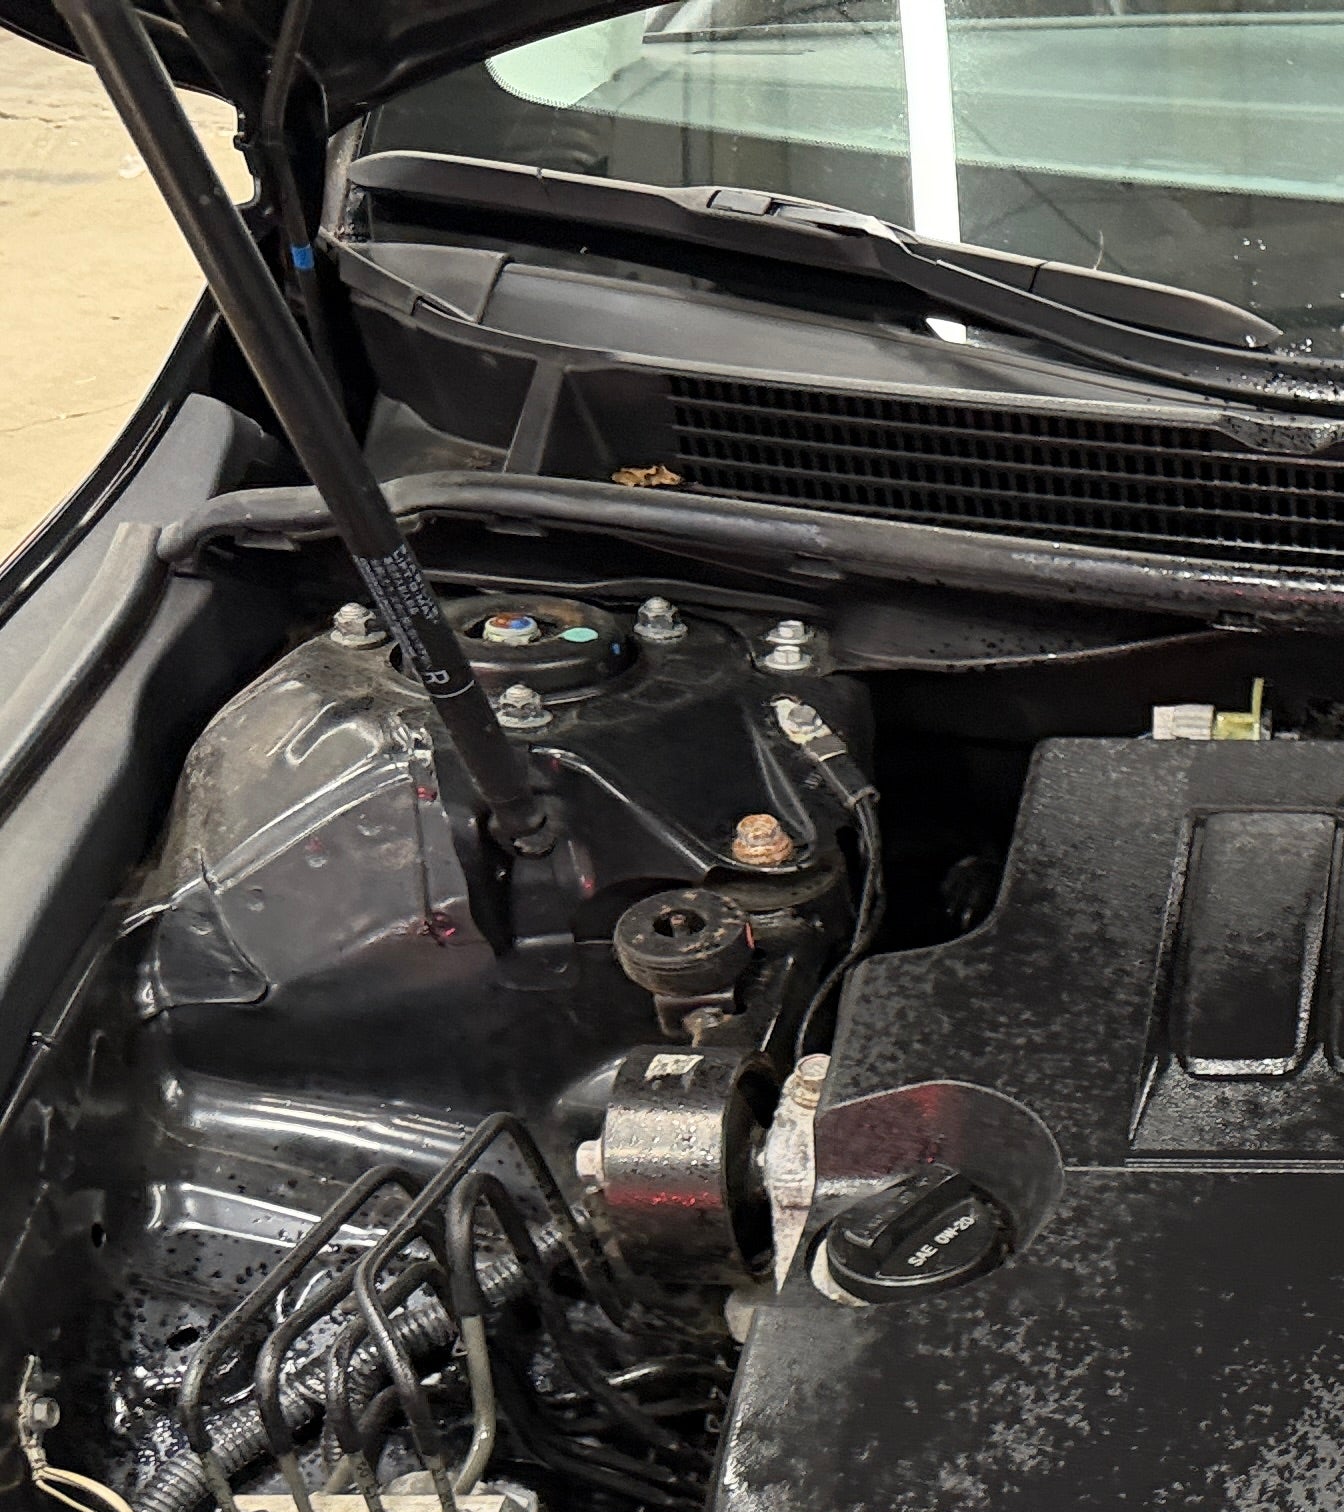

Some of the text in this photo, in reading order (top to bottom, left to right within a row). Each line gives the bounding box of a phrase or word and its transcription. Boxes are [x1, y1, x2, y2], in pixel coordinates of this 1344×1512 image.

[425, 669, 451, 685] R
[908, 1216, 976, 1268] SAE 0W-20
